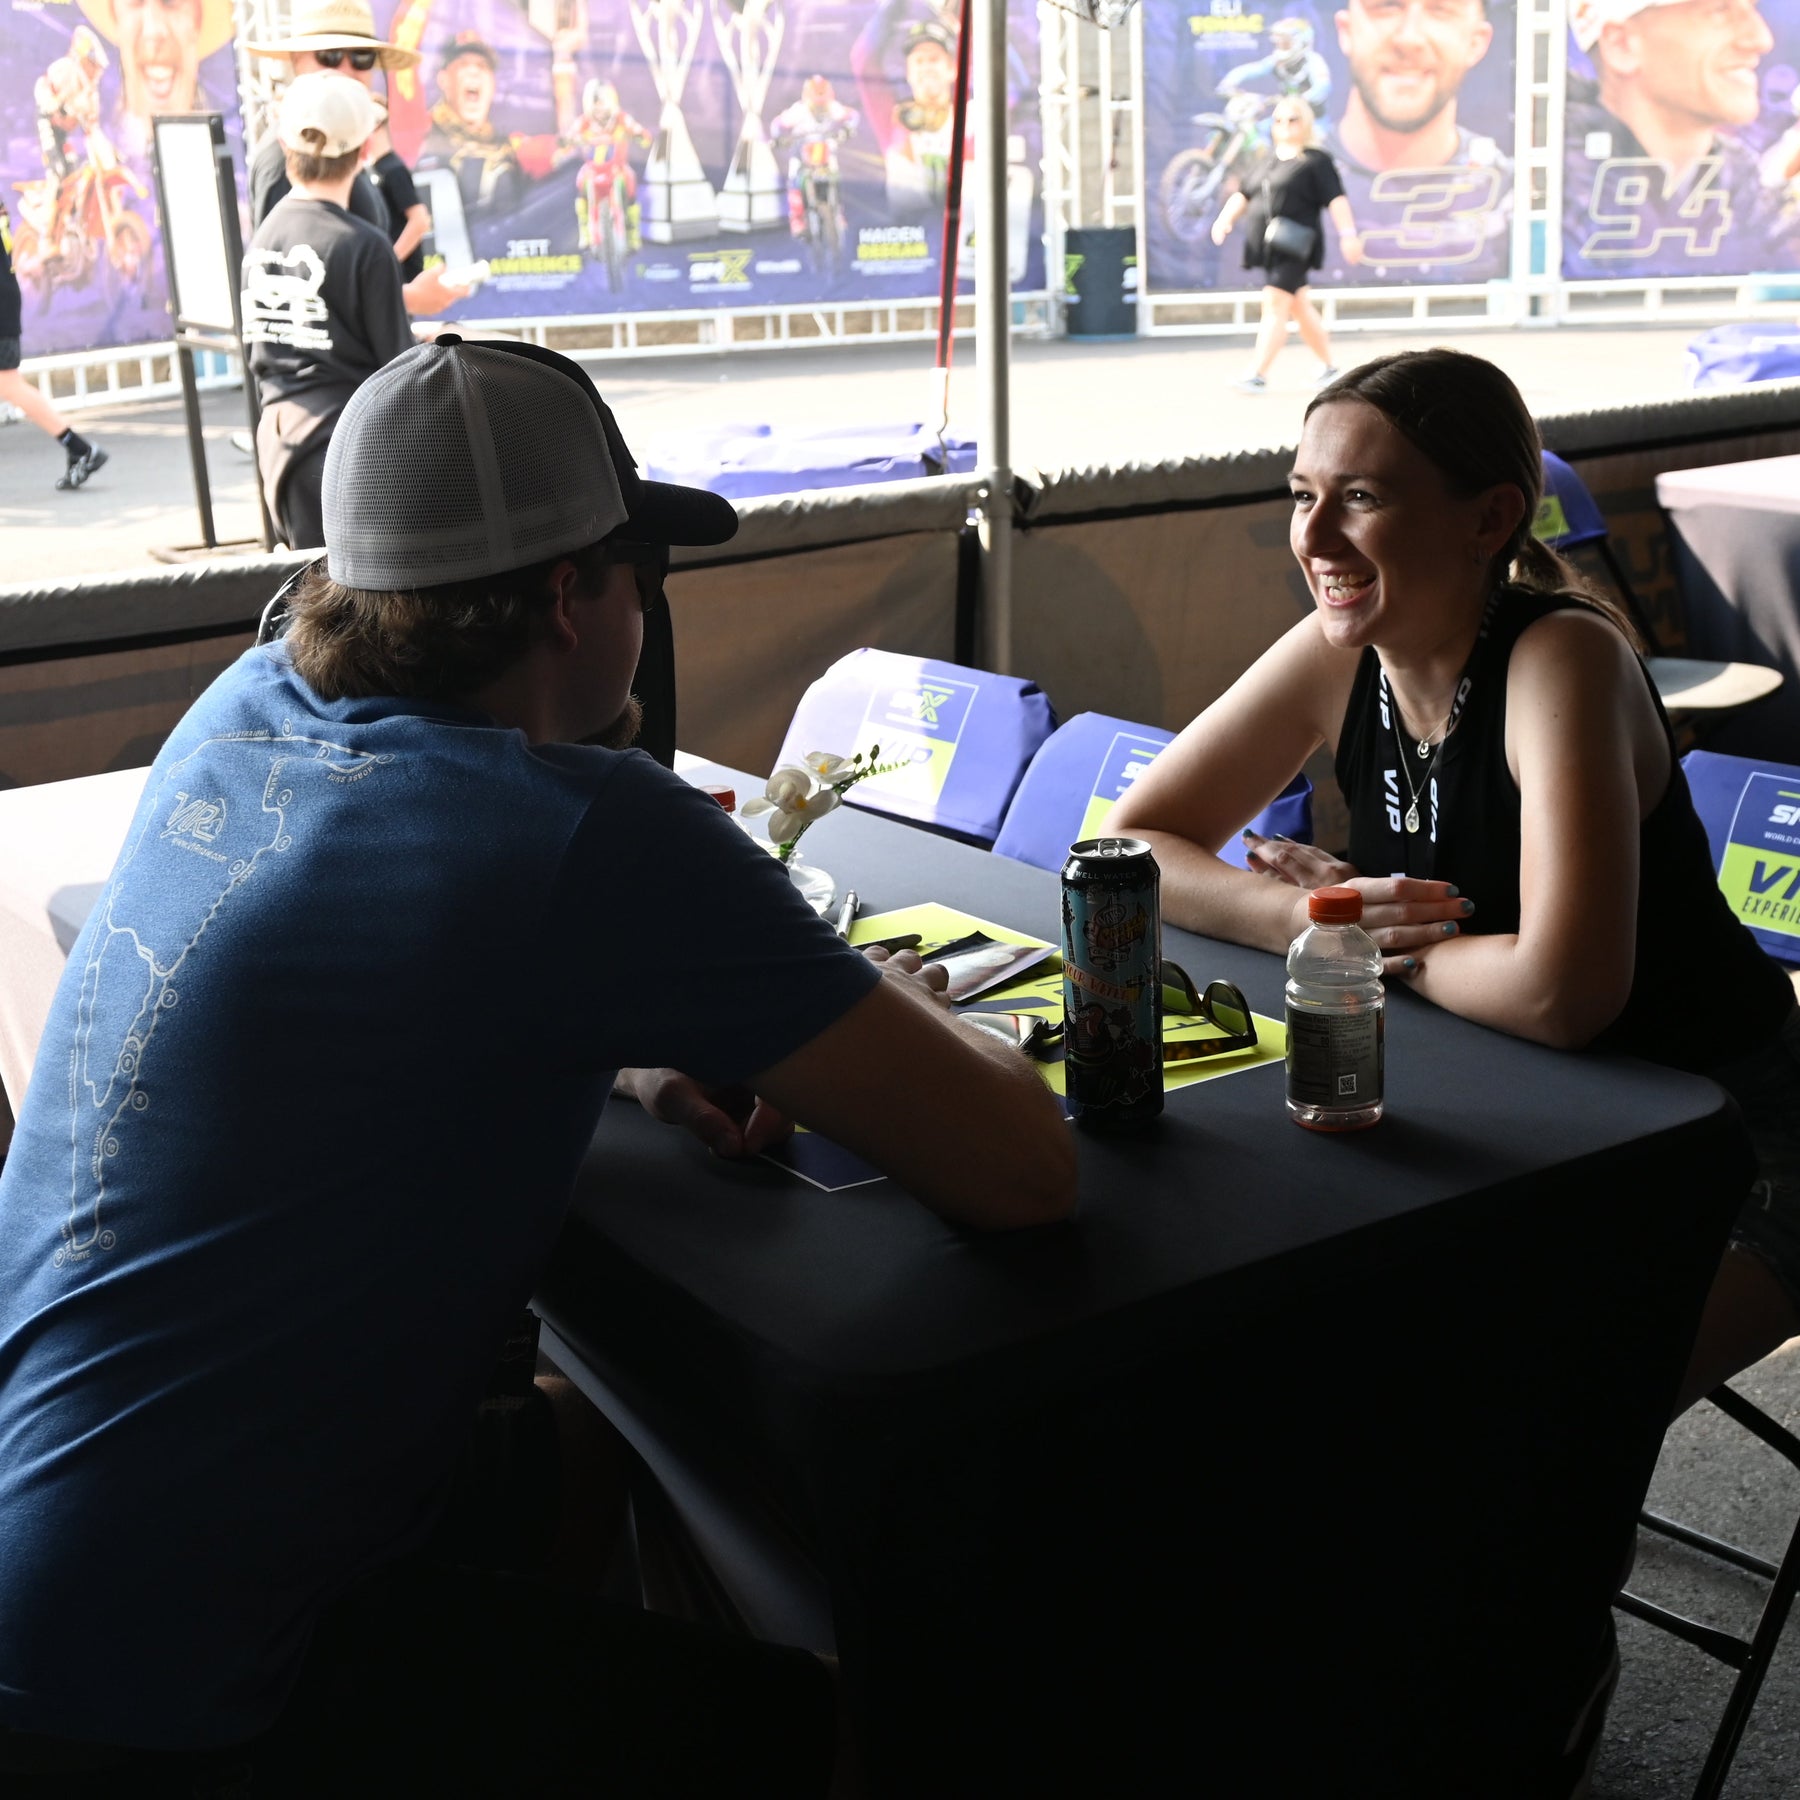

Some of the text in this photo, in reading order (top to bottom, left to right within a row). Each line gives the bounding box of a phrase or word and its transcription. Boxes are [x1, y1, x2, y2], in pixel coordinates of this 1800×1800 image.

[1358, 166, 1501, 266] 3
[1578, 156, 1734, 259] 94
[506, 239, 551, 258] JETT
[490, 255, 582, 275] AWRENCE
[348, 766, 375, 783] HORSE
[1384, 769, 1401, 833] VIP
[1430, 777, 1439, 843] VIP
[1764, 831, 1792, 844] WORLD
[1075, 871, 1099, 880] WELL
[1103, 872, 1137, 881] WATER
